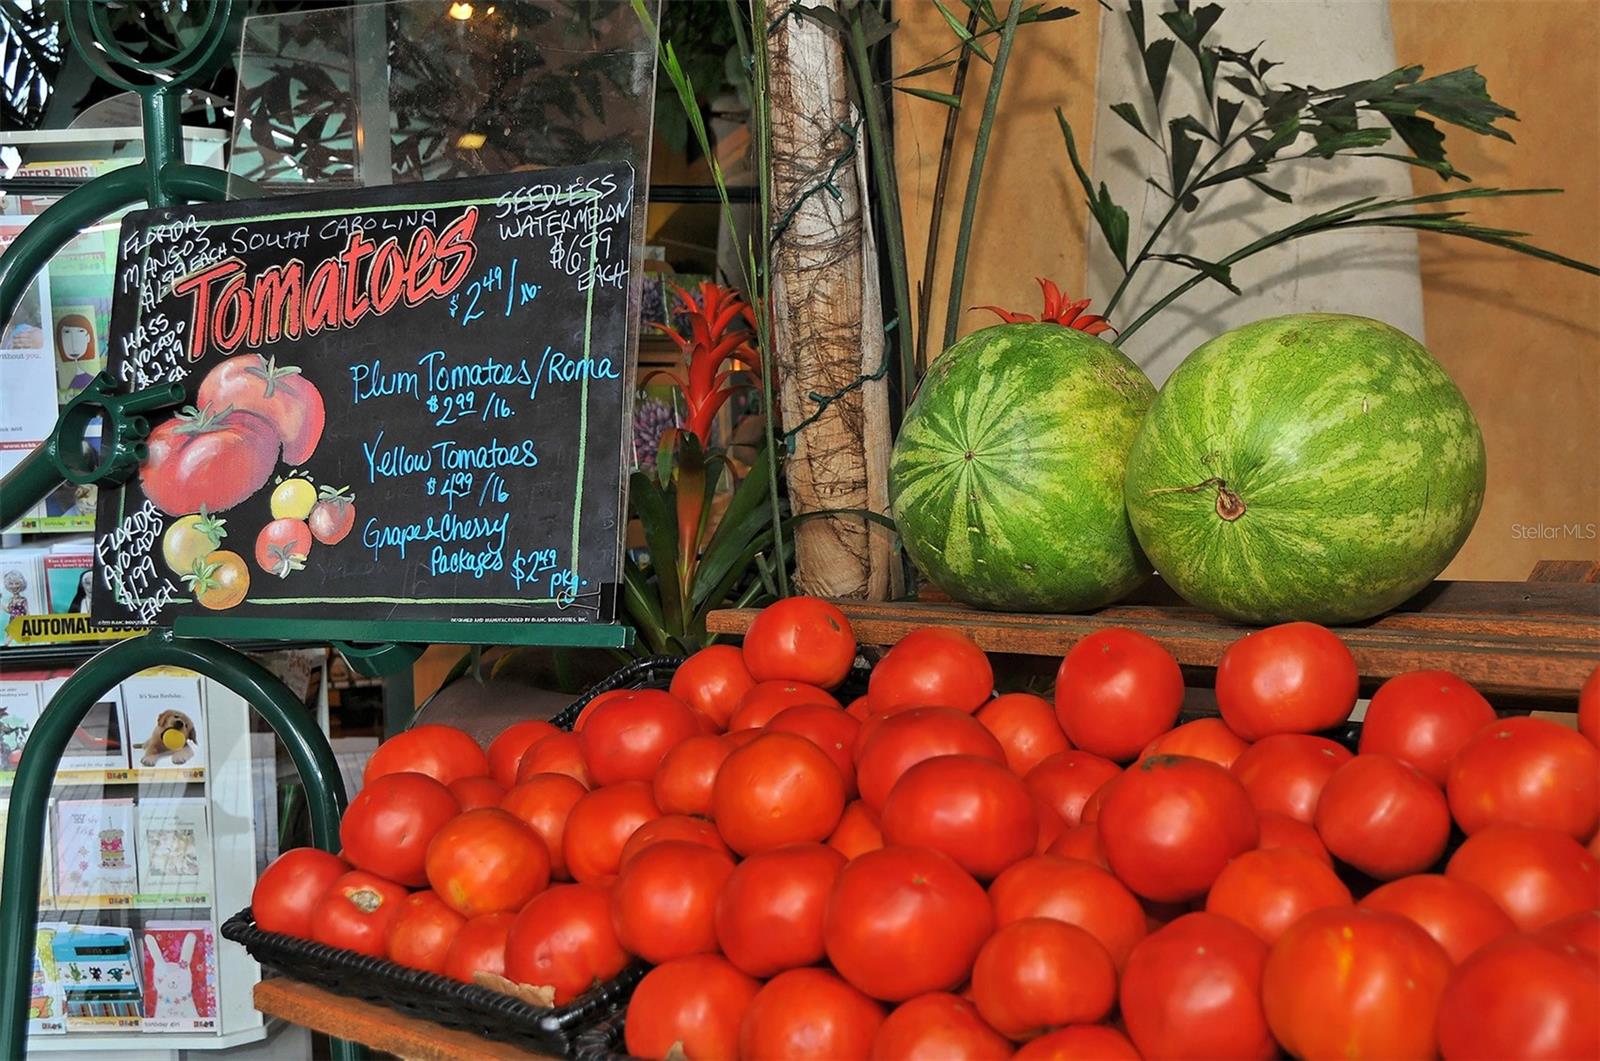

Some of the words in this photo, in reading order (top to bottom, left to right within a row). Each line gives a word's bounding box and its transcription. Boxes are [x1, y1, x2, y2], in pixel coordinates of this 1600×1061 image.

[495, 174, 617, 218] SEEDLESS
[499, 194, 632, 241] WATERMELON
[232, 225, 311, 254] SOUTH
[319, 210, 438, 241] CAROLINA
[123, 224, 212, 294] MANGOS
[189, 242, 228, 272] EACH
[577, 260, 629, 292] EACH
[172, 205, 479, 363] Tomatoes
[121, 321, 186, 382] AVOCADO
[122, 313, 170, 356] HASS
[350, 360, 420, 405] Plum
[363, 430, 432, 484] Yellow
[431, 438, 539, 470] Tomatoes
[103, 517, 163, 590] AVOCADO
[431, 546, 505, 580] Packages
[140, 578, 178, 624] EACH
